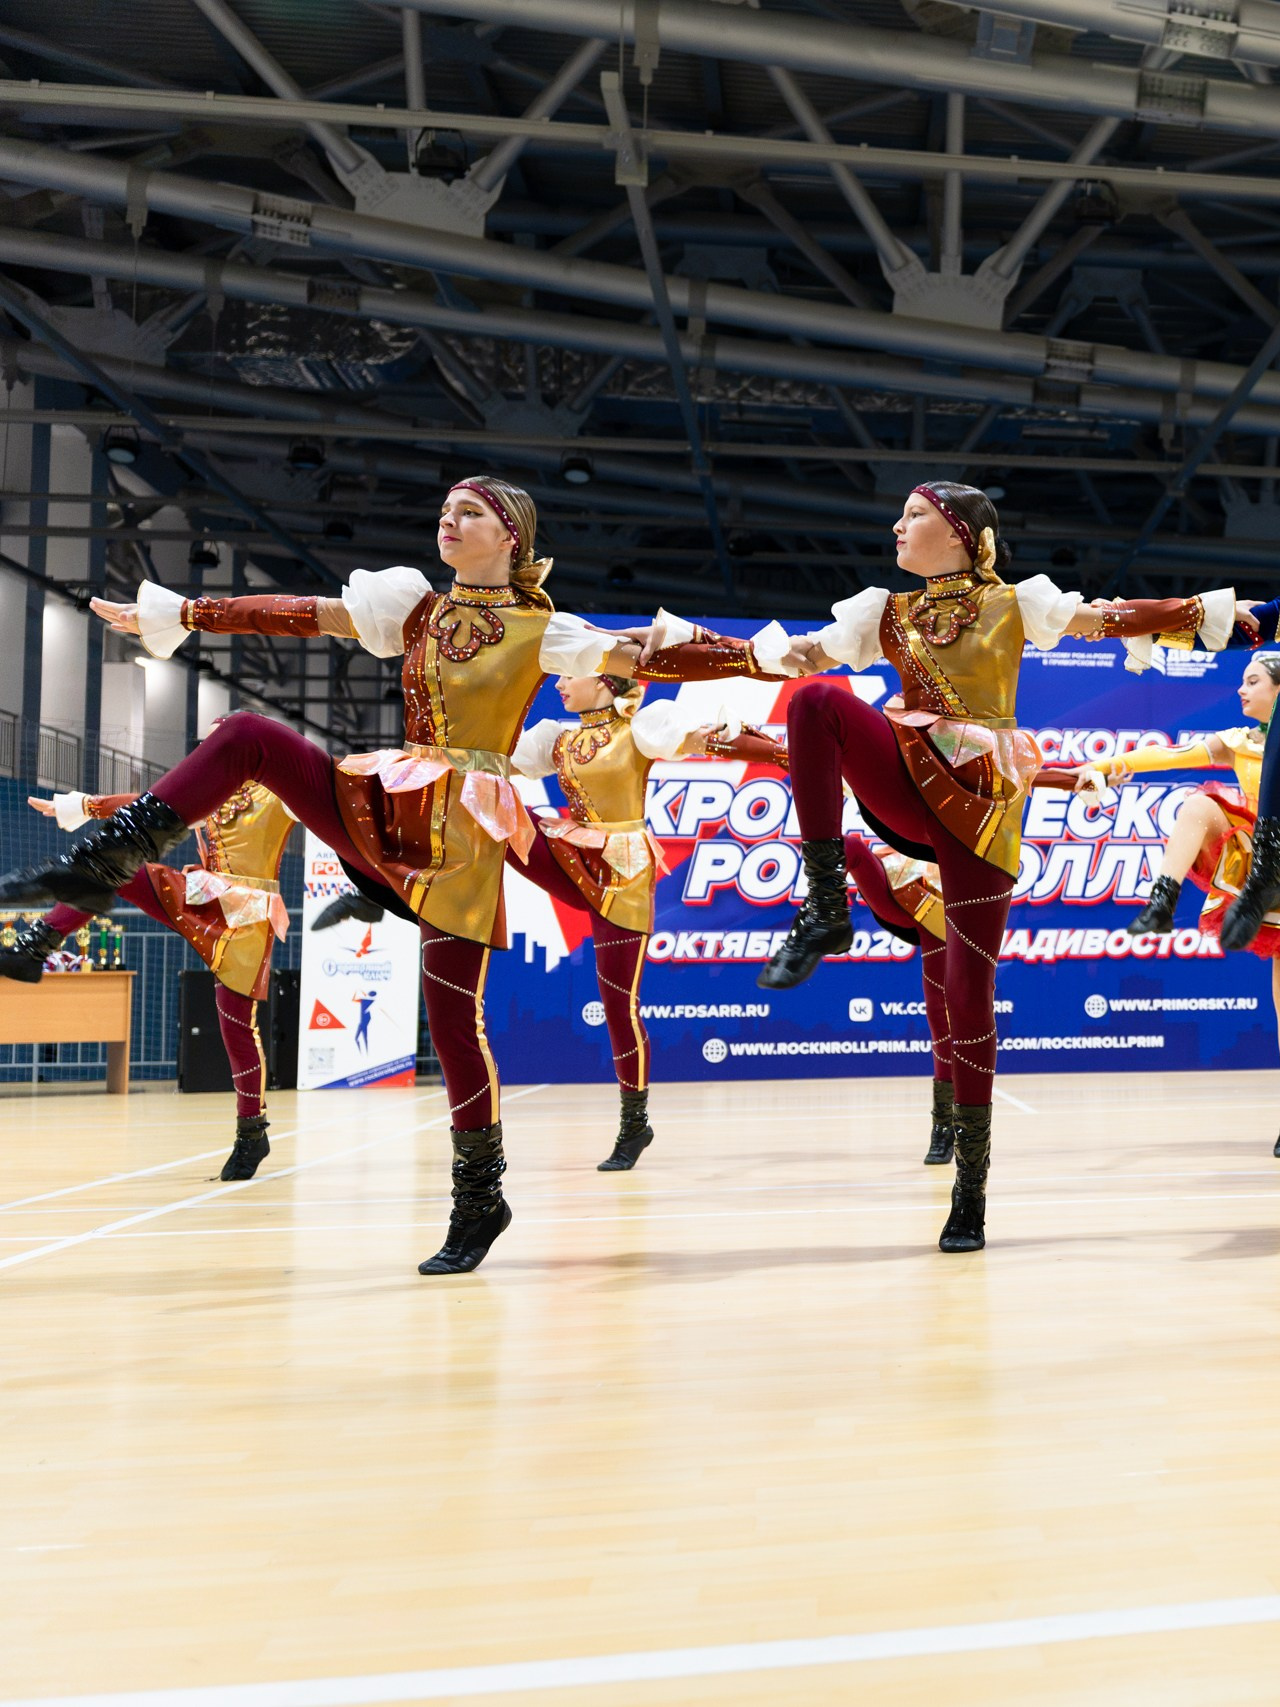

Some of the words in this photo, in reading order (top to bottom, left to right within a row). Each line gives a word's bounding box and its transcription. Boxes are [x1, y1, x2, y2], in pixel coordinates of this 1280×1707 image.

[647, 931, 787, 959] ОКТЯБР
[828, 931, 914, 958] 026
[999, 929, 1221, 959] АДИВОСТОК
[639, 1004, 770, 1019] WW.FDSARR.RU
[1109, 998, 1258, 1011] WWW.PRIMORSKY.RU
[730, 1041, 932, 1056] WWW.ROCKNROLLPRIM.RU
[996, 1036, 1165, 1050] .COM/ROCKNROLLPRIM
